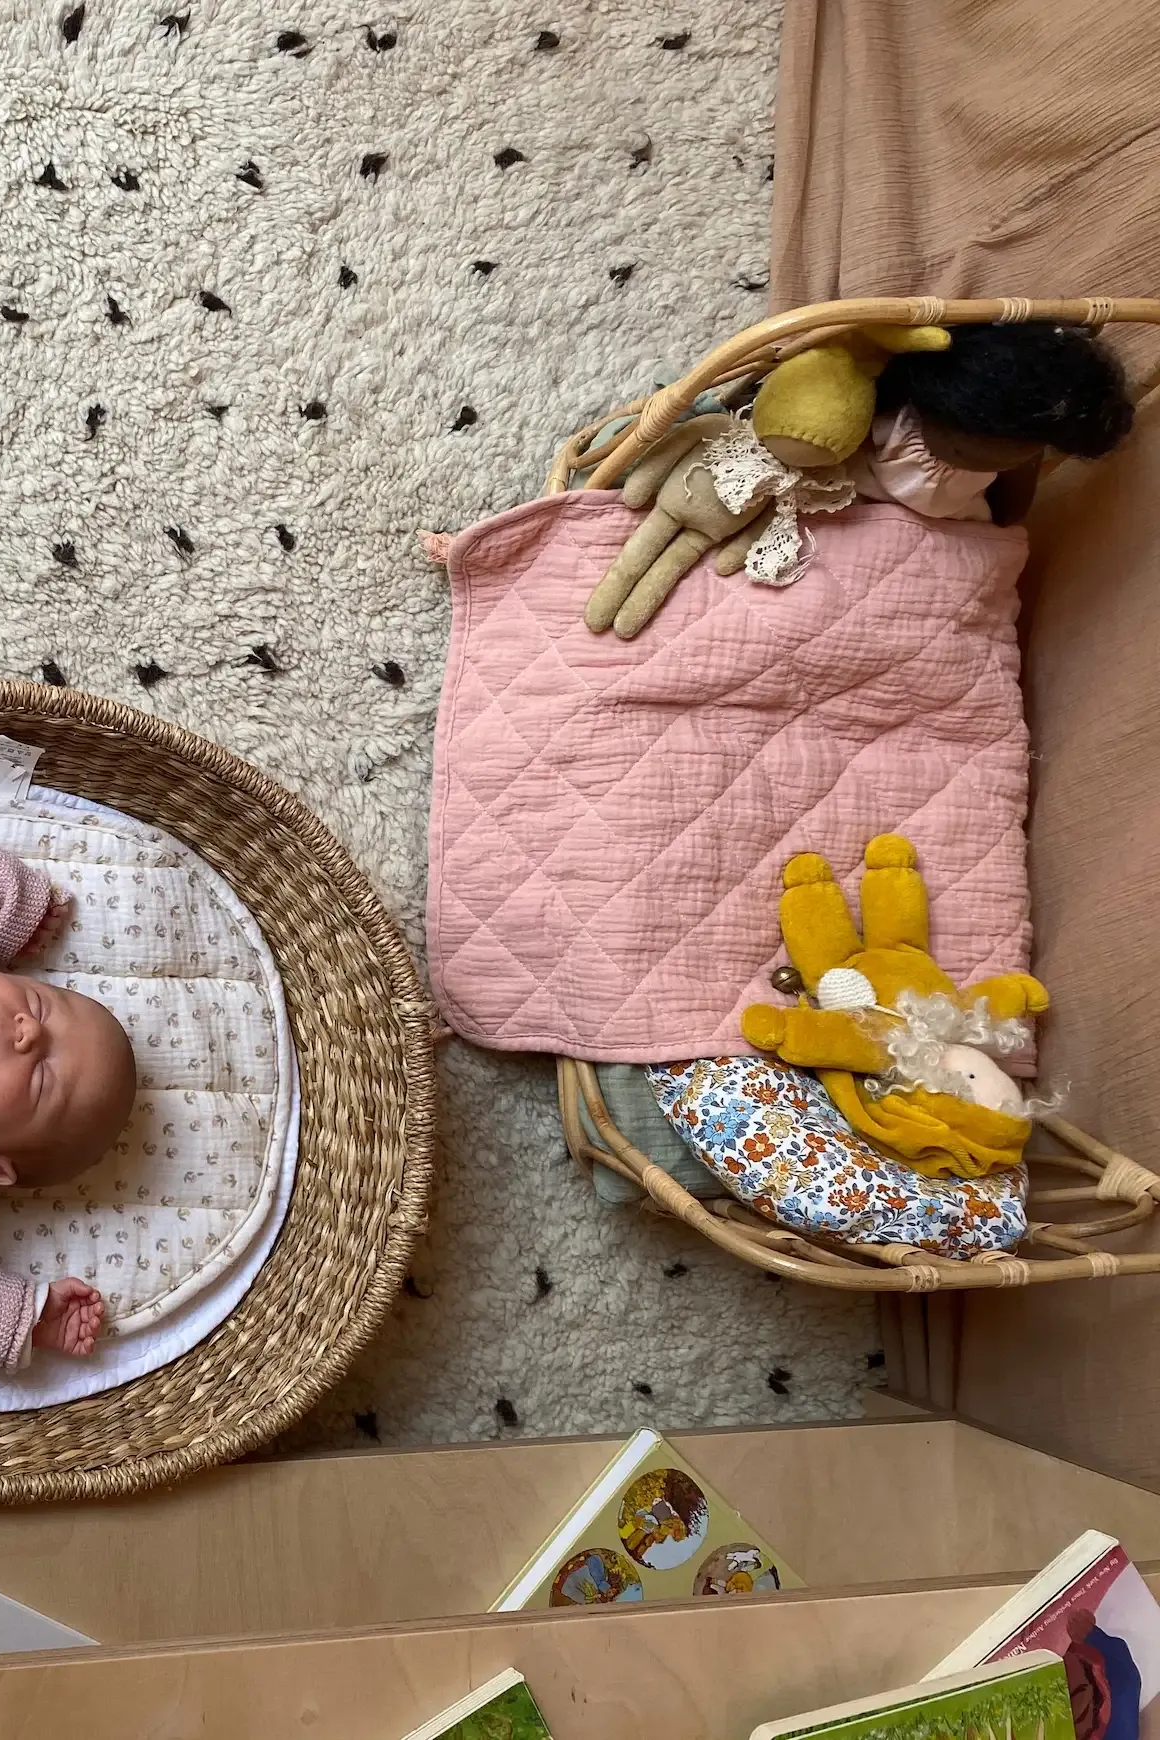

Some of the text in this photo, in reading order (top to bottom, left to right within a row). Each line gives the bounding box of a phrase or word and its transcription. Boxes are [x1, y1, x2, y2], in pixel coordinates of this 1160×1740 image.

[1099, 1565, 1110, 1576] New
[1086, 1576, 1099, 1589] York
[1071, 1588, 1086, 1602] Times
[1025, 1624, 1045, 1643] Author
